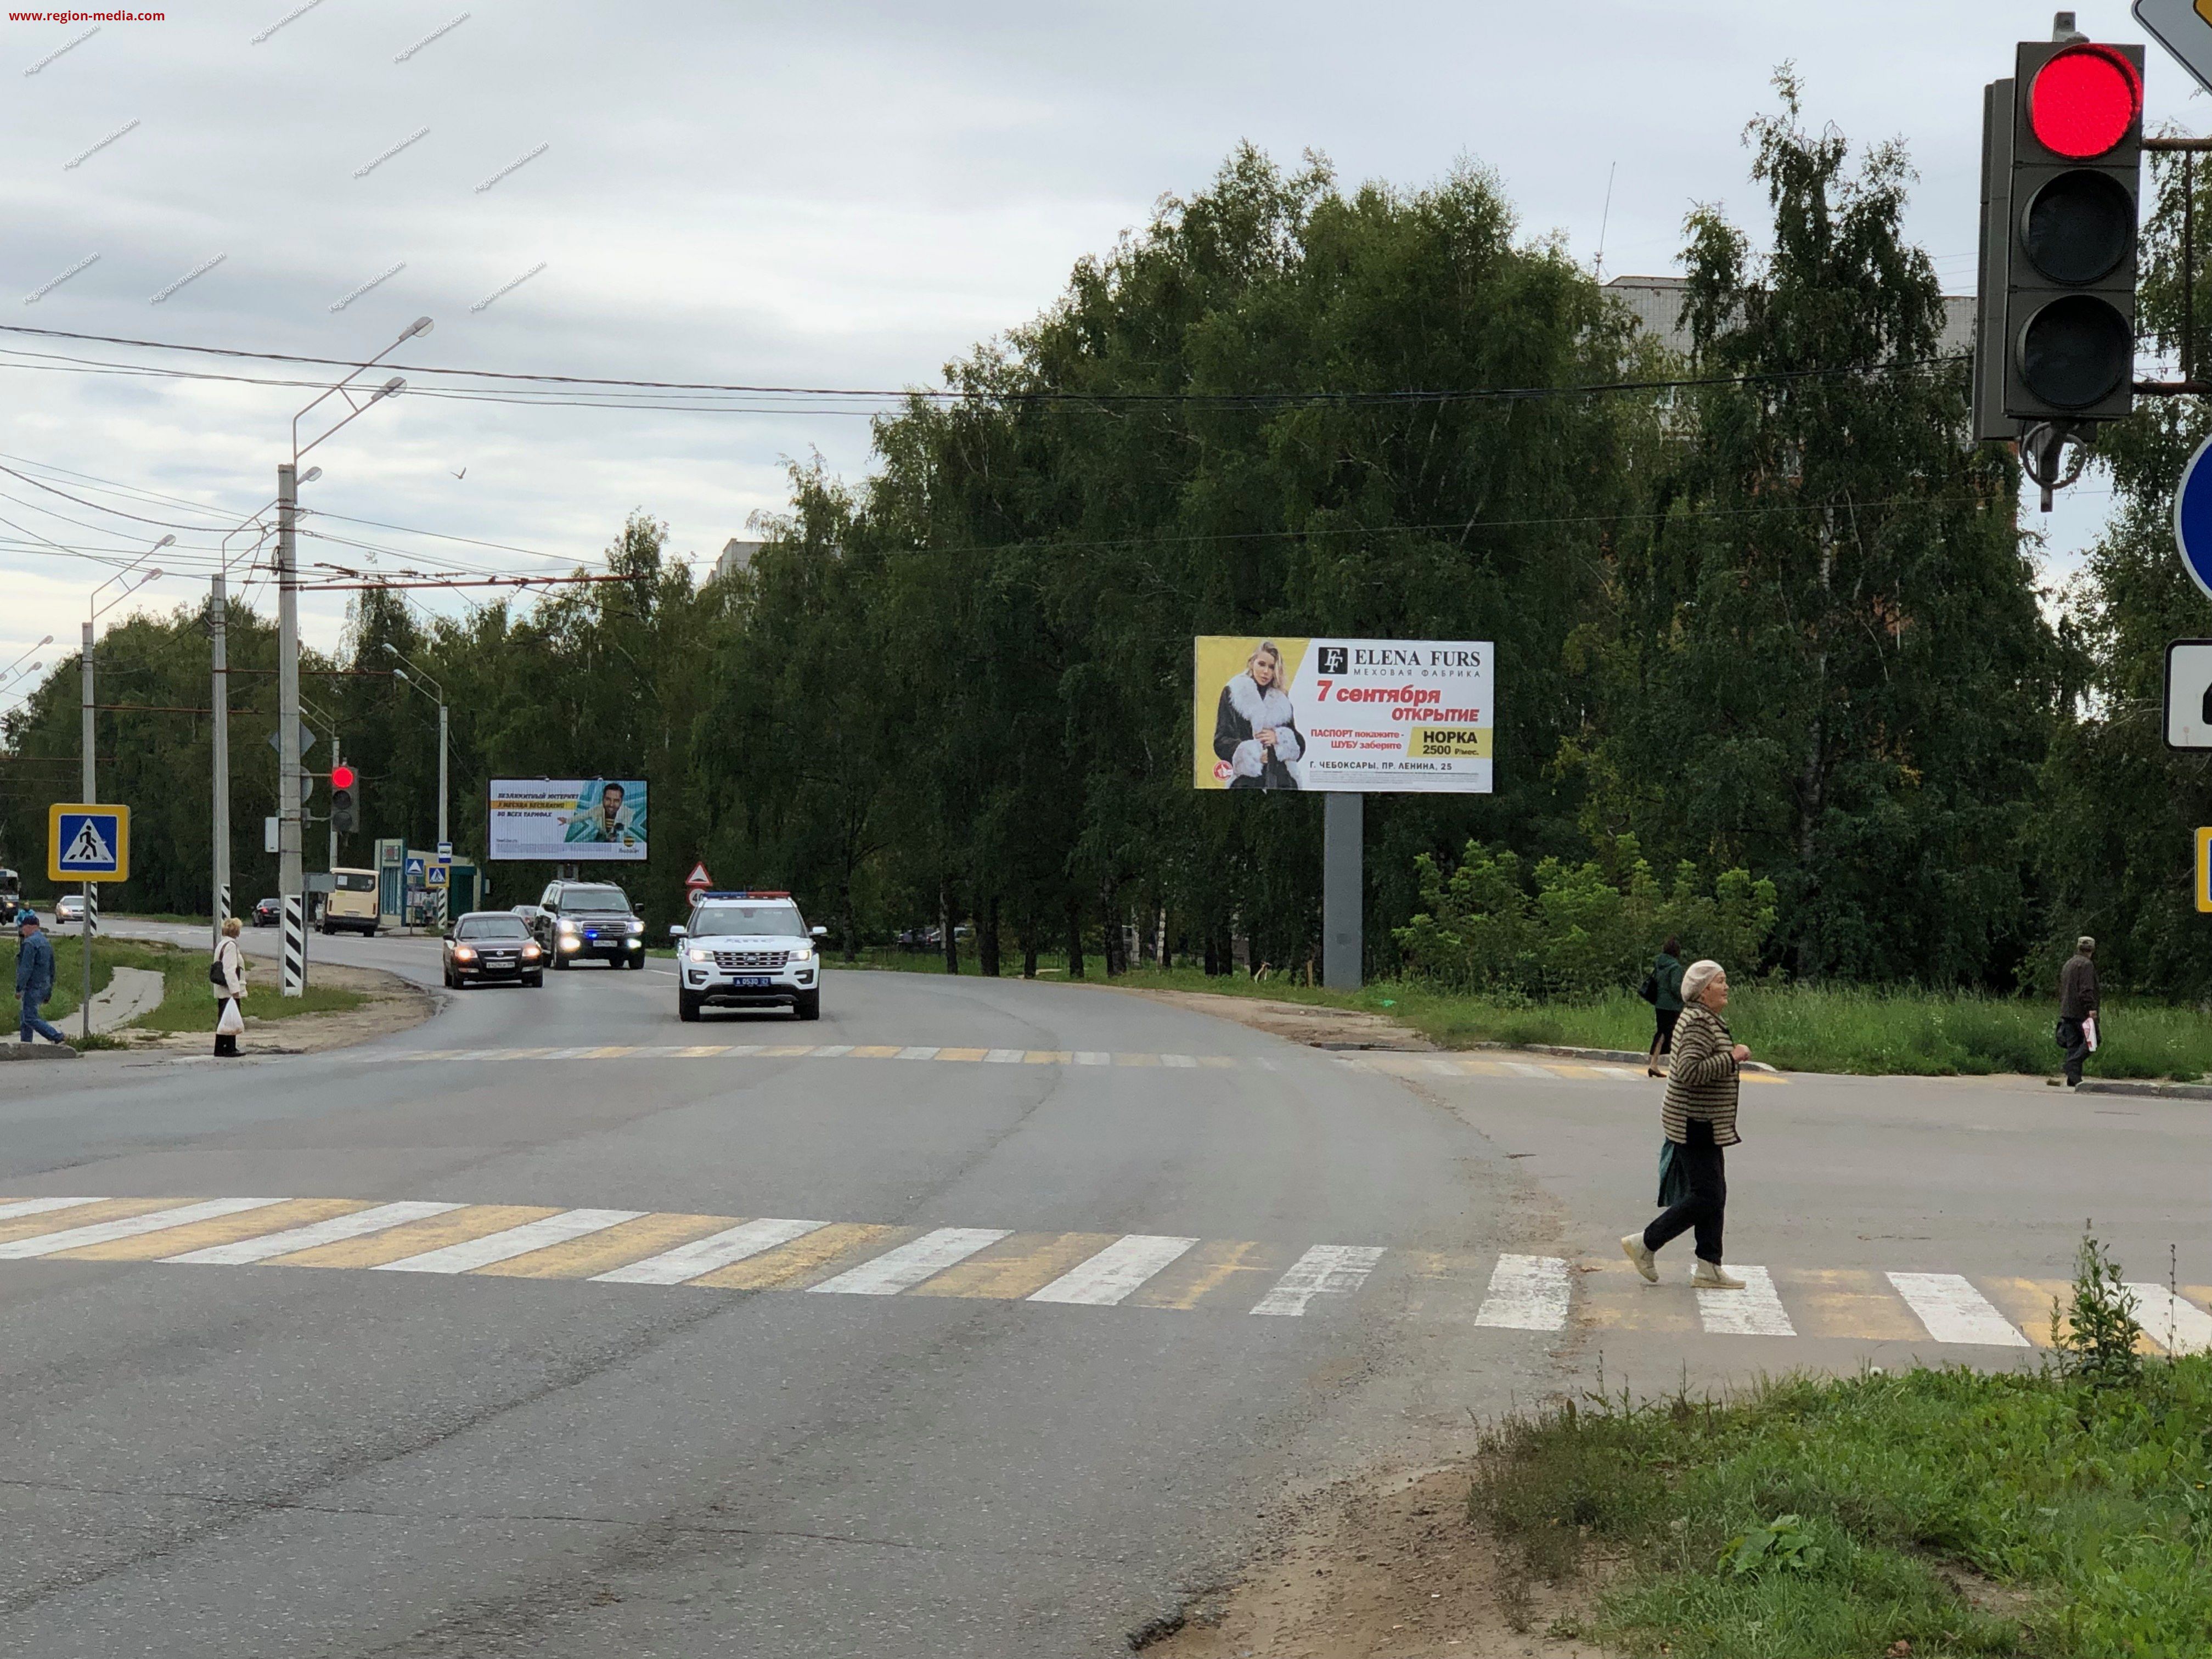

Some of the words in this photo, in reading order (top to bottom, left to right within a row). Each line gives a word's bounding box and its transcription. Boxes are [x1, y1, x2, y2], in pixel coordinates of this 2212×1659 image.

[1355, 649, 1422, 666] ELENA
[1430, 650, 1481, 667] FURS
[1354, 668, 1412, 677] МЕХОВАЯ
[1421, 670, 1481, 678] ФАБРИКА
[1317, 680, 1333, 702] 7
[1336, 684, 1441, 707] сентября
[1391, 707, 1480, 722] ОТКРЫТИЕ
[1310, 729, 1353, 738] ПАСПОРТ
[1423, 730, 1478, 744] НОРКА
[1331, 740, 1358, 750] ШУБУ
[1359, 741, 1402, 751] заберите
[1422, 745, 1451, 755] 2500
[1398, 762, 1438, 771] ЛЕНИНА,
